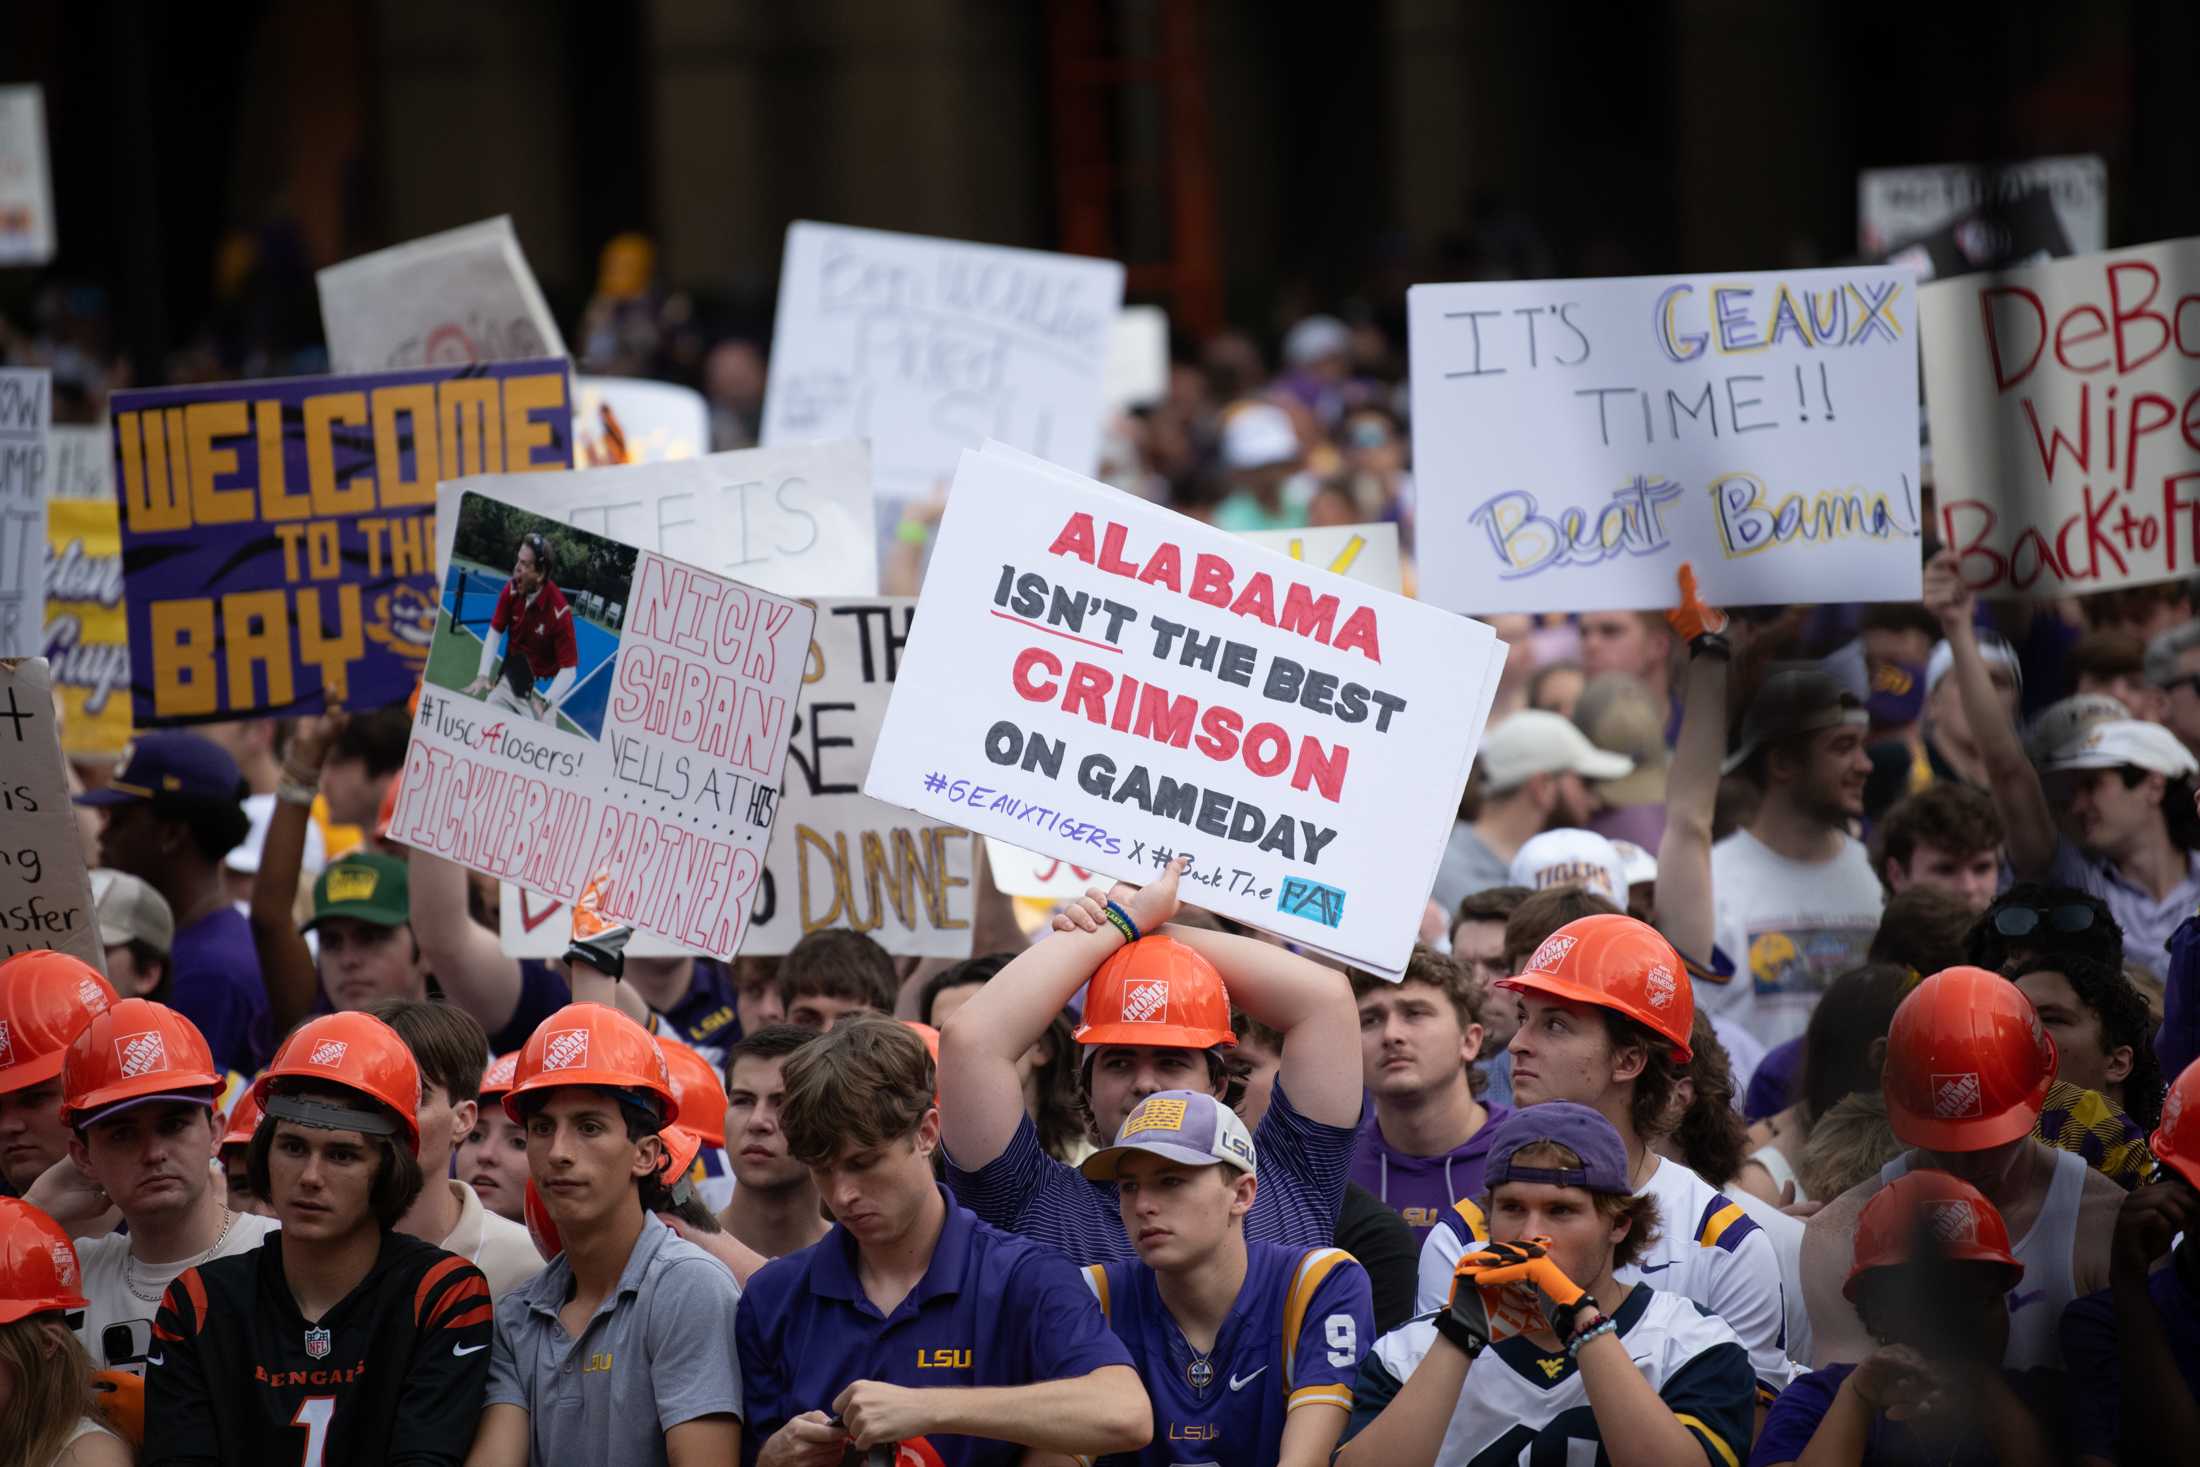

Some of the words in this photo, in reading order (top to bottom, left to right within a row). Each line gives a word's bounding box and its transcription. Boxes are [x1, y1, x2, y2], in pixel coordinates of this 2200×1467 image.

[1445, 302, 1590, 378] IT'S
[1655, 281, 1902, 362] GEAUX
[118, 373, 566, 533] WELCOME
[275, 520, 341, 582] TO
[720, 473, 820, 568] IS
[1469, 474, 1683, 580] Beat
[1710, 471, 1922, 560] Bama!
[1942, 485, 2128, 591] Back
[1049, 512, 1381, 664] ALABAMA
[150, 584, 366, 717] BAY
[631, 557, 793, 684] NICK
[993, 563, 1137, 646] ISN'T
[1150, 615, 1258, 688] THE
[1262, 656, 1407, 734] BEST
[614, 645, 785, 776] SABAN
[1012, 647, 1350, 803] CRIMSON
[610, 729, 690, 801] YELLS
[695, 767, 752, 816] AT
[745, 780, 777, 828] HIS
[985, 720, 1066, 781] ON
[1078, 753, 1338, 865] GAMEDAY
[391, 738, 591, 899] PICKLEBALL
[580, 805, 759, 955] PARTNER
[794, 823, 969, 936] DUNNE
[1124, 980, 1168, 1021] HOME
[1129, 984, 1146, 1001] THE
[1139, 996, 1167, 1021] DEPOT
[122, 1031, 161, 1077] HOME
[123, 1038, 138, 1057] THE
[140, 1042, 164, 1073] DEPOT
[310, 1042, 347, 1064] HOME
[544, 1029, 588, 1070] HOME
[549, 1034, 567, 1050] THE
[560, 1042, 588, 1068] DEPOT
[1936, 1073, 1978, 1113] HOME
[1221, 1130, 1255, 1166] LSU
[308, 1340, 329, 1354] NFL
[917, 1349, 973, 1369] LSU
[1323, 1314, 1358, 1369] 9
[289, 1395, 337, 1467] 1
[1169, 1422, 1215, 1441] LSU
